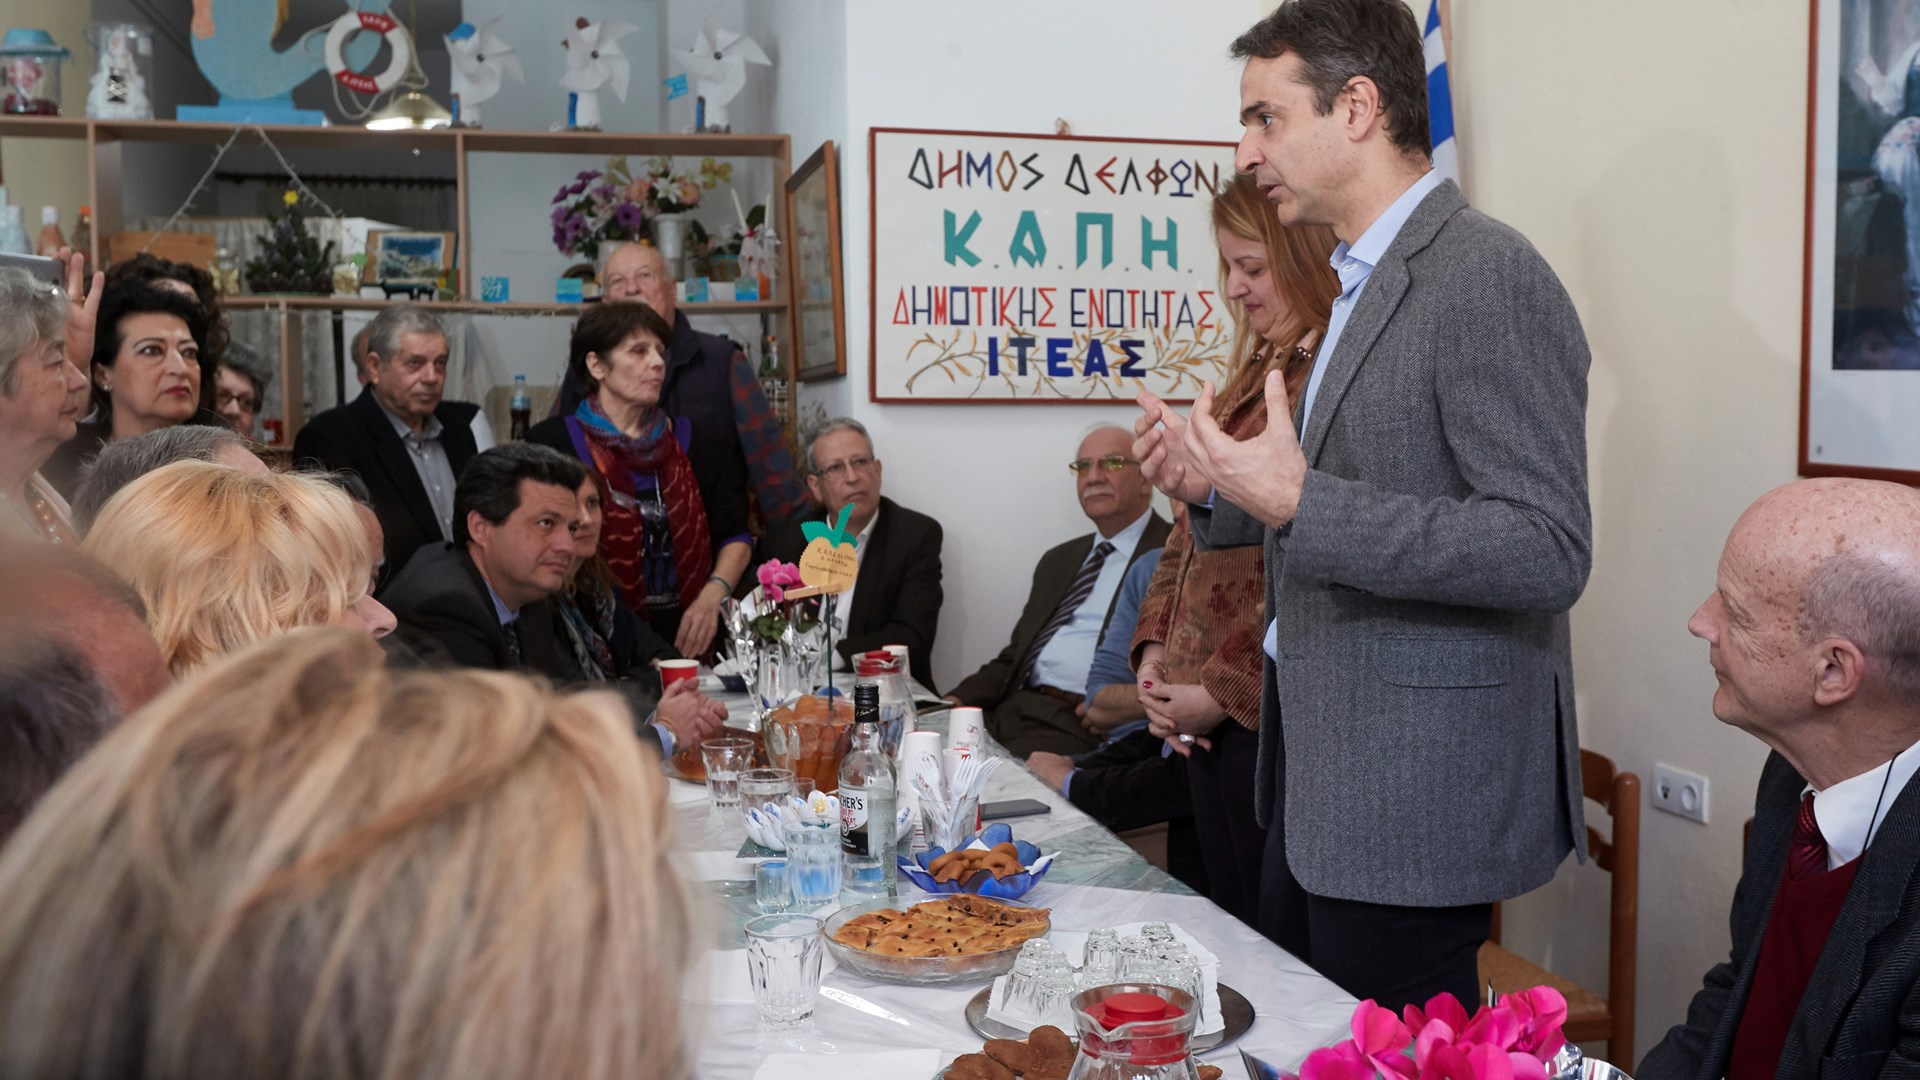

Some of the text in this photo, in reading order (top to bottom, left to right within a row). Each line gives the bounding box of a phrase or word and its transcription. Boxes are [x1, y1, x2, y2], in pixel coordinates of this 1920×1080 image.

[908, 148, 1218, 197] ΔΗΜΟΣ ΔΕΛΦΩΝ
[893, 286, 1215, 329] ΔΗΜΟΤΙΚΗΣ ΕΝΟΤΗΤΑΣ
[988, 336, 1146, 377] ΙΤΕΑΣ
